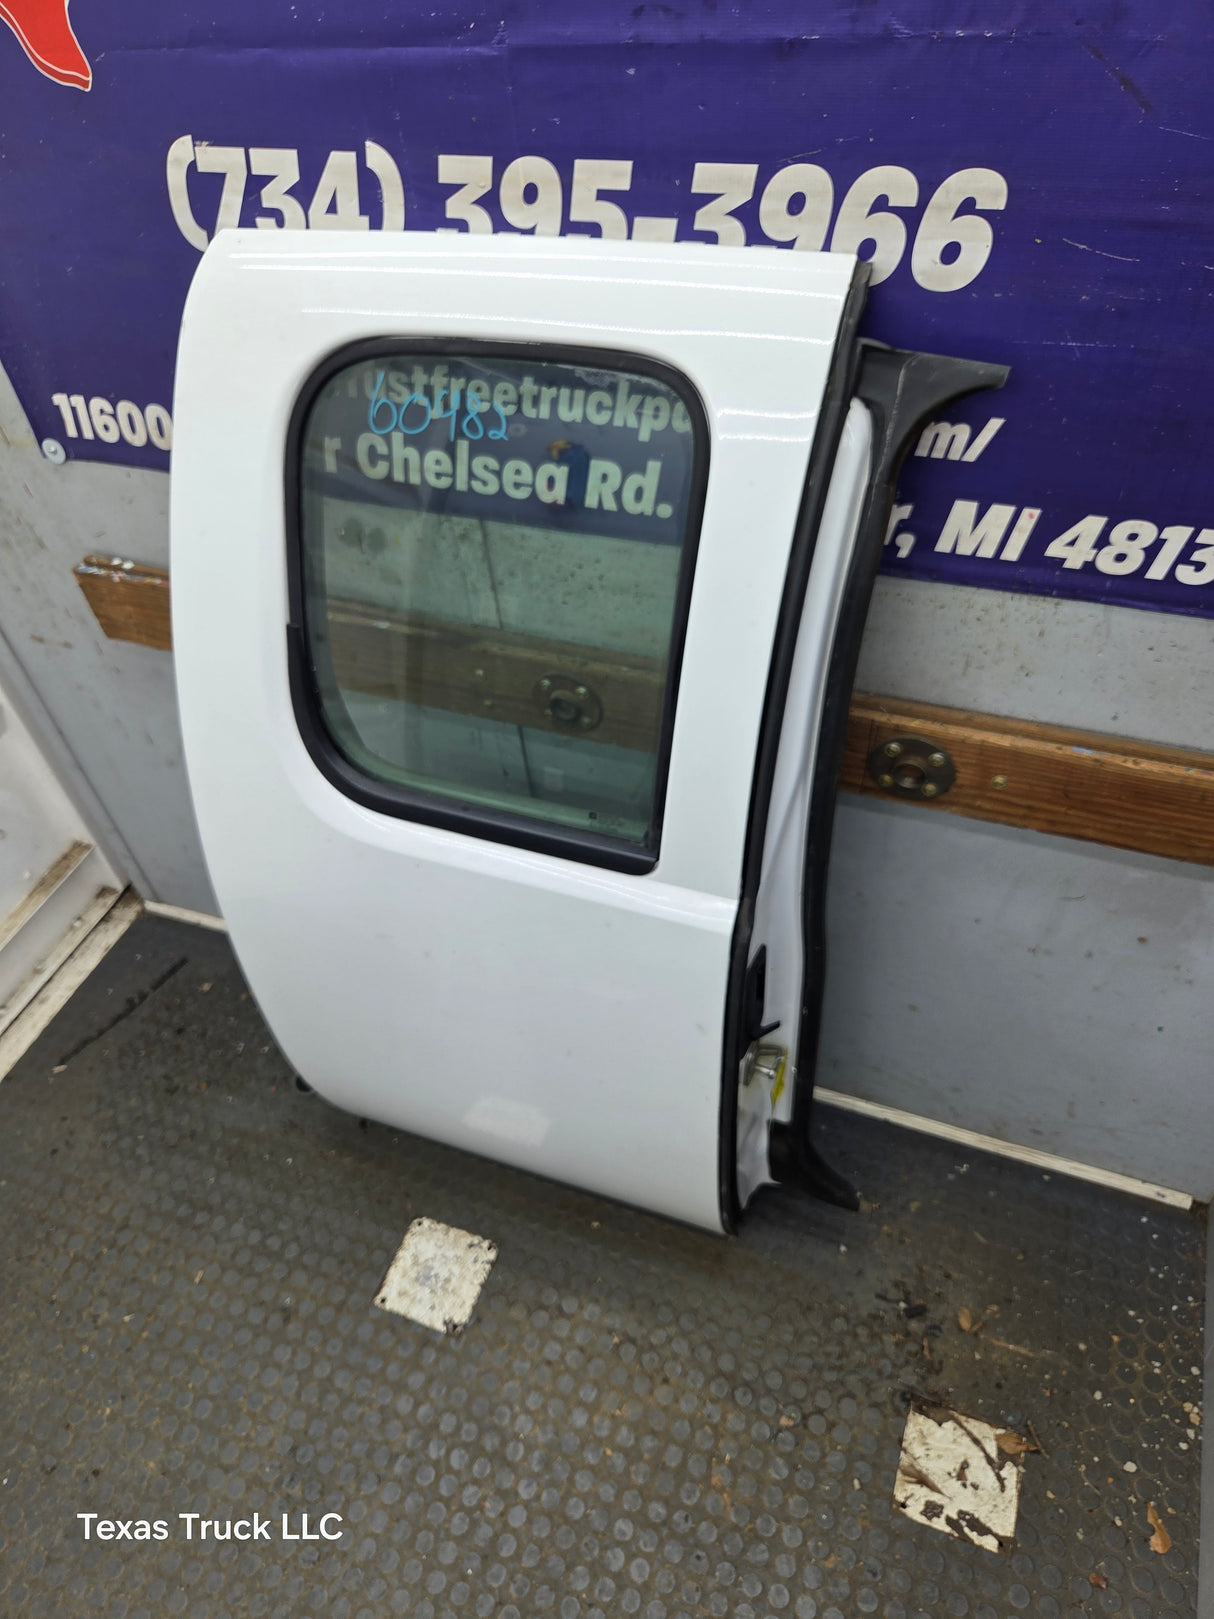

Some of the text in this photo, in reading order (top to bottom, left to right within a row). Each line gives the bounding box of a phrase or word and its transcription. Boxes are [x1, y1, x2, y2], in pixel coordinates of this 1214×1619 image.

[166, 134, 1008, 292] (734) 395-3966
[52, 393, 173, 450] 11600
[356, 431, 569, 506] Chelsea
[584, 459, 674, 519] Rd.
[934, 499, 1042, 562] MI
